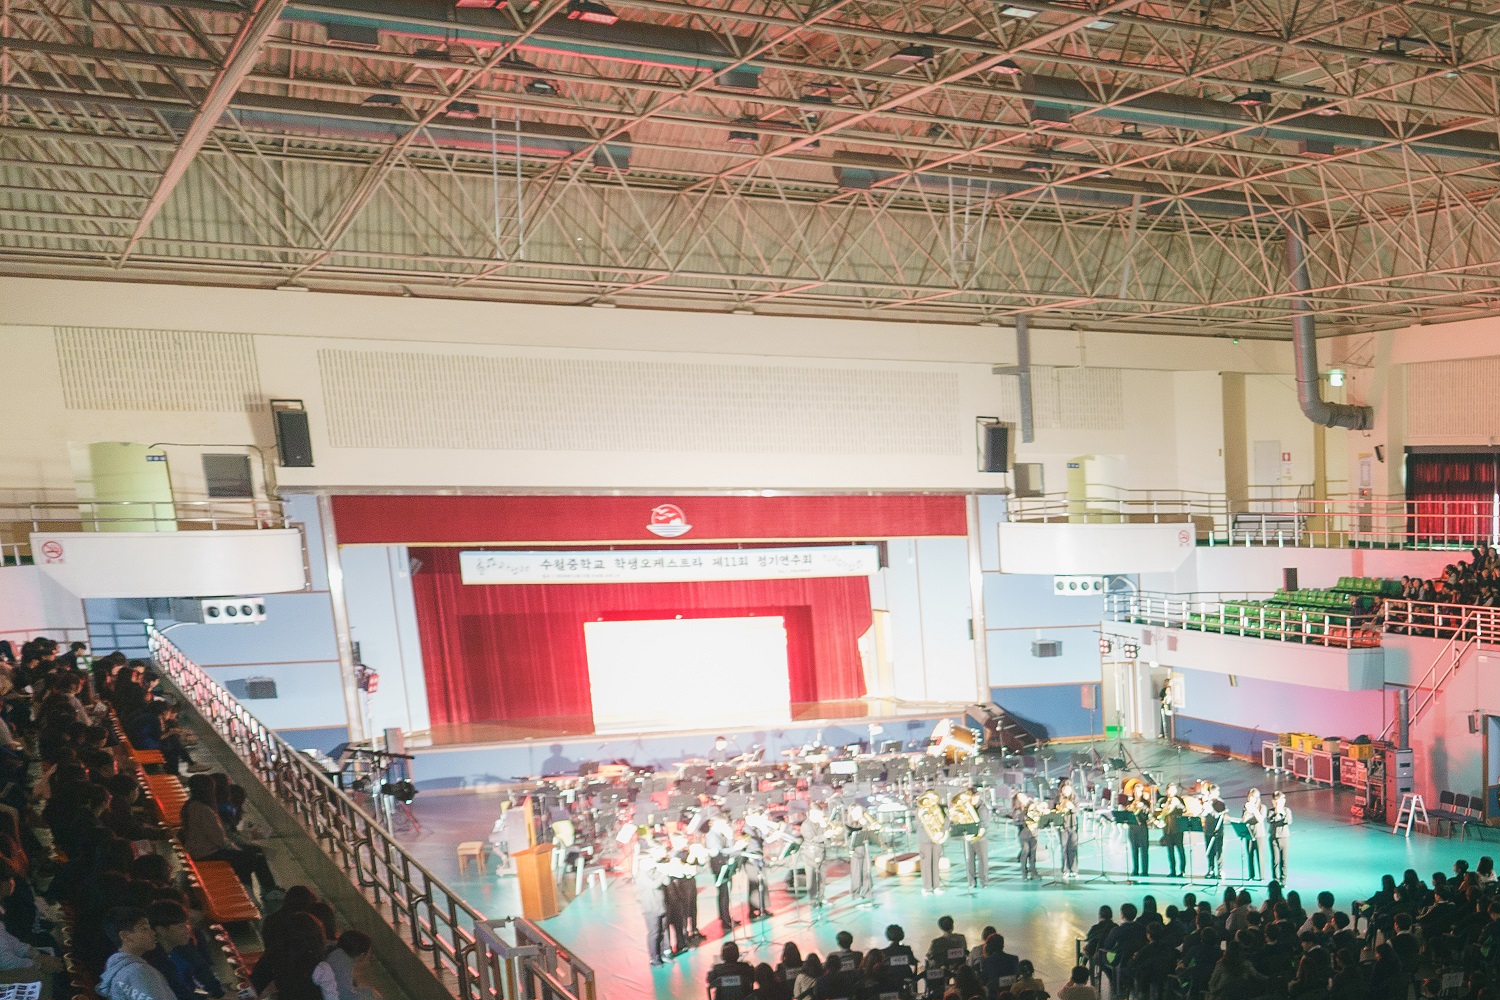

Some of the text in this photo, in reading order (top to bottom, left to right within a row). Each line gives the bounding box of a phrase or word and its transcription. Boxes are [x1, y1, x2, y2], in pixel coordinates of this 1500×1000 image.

[540, 553, 812, 571] 수월중학교 학생오케스트라 제11회 정기연주회
